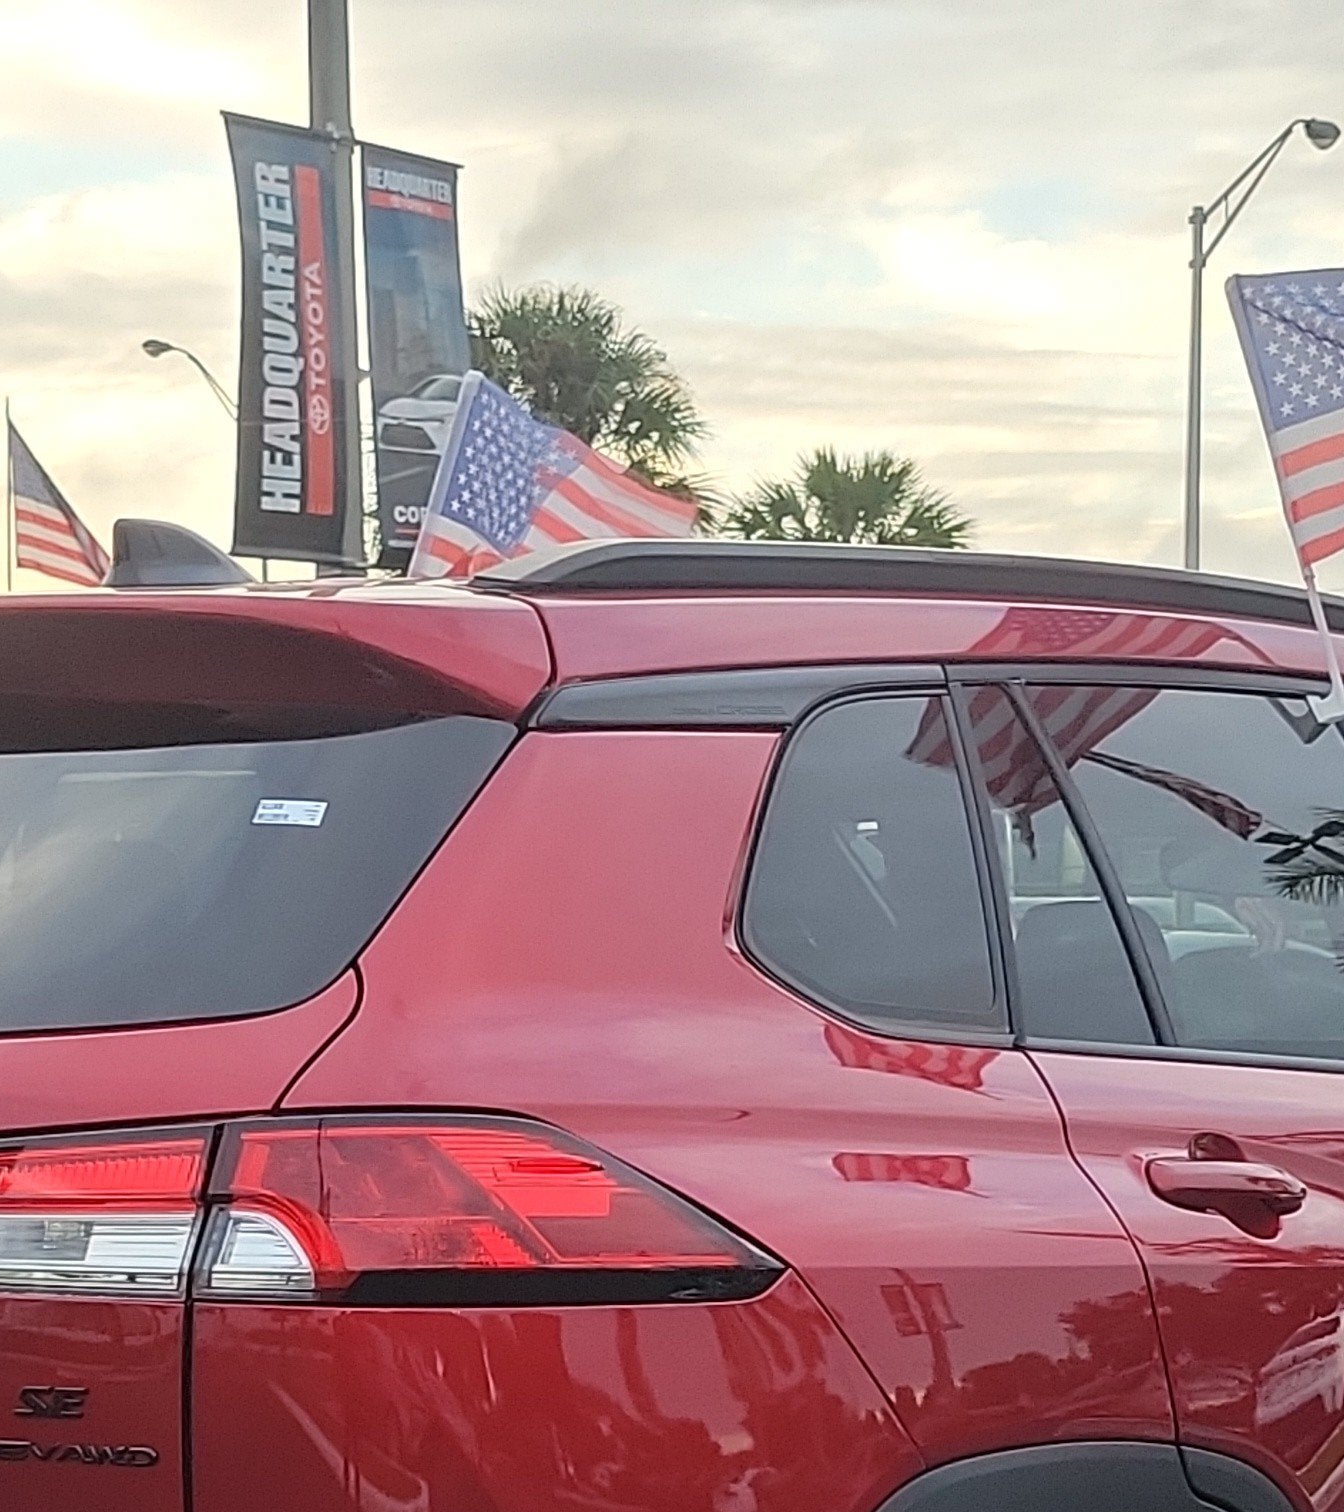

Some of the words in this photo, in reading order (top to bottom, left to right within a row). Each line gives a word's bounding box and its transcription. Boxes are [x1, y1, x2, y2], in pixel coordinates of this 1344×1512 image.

[255, 161, 304, 514] HEADQUARTER
[304, 262, 327, 391] TOYOTA
[12, 1385, 90, 1418] SE
